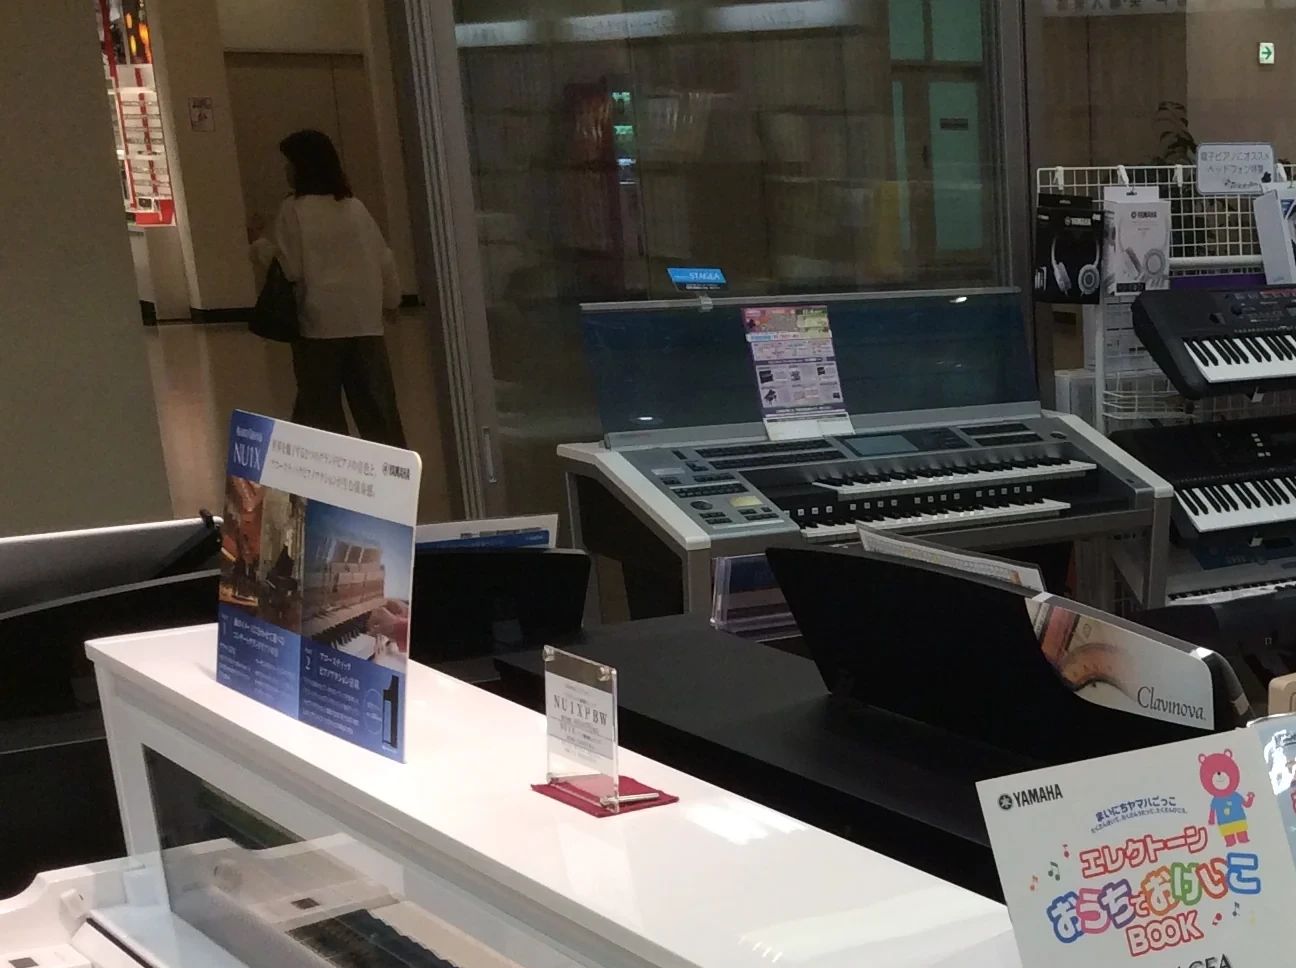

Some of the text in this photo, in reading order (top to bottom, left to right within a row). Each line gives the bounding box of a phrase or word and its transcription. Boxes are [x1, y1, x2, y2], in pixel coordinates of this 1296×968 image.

[233, 442, 262, 471] NU1X
[1012, 783, 1064, 809] YAMAHA
[1096, 796, 1177, 822] まいにちヤマハごっこ
[1080, 826, 1208, 879] エレクトーン
[1046, 852, 1261, 944] おうちでおけいこ
[1126, 911, 1204, 957] BOOK
